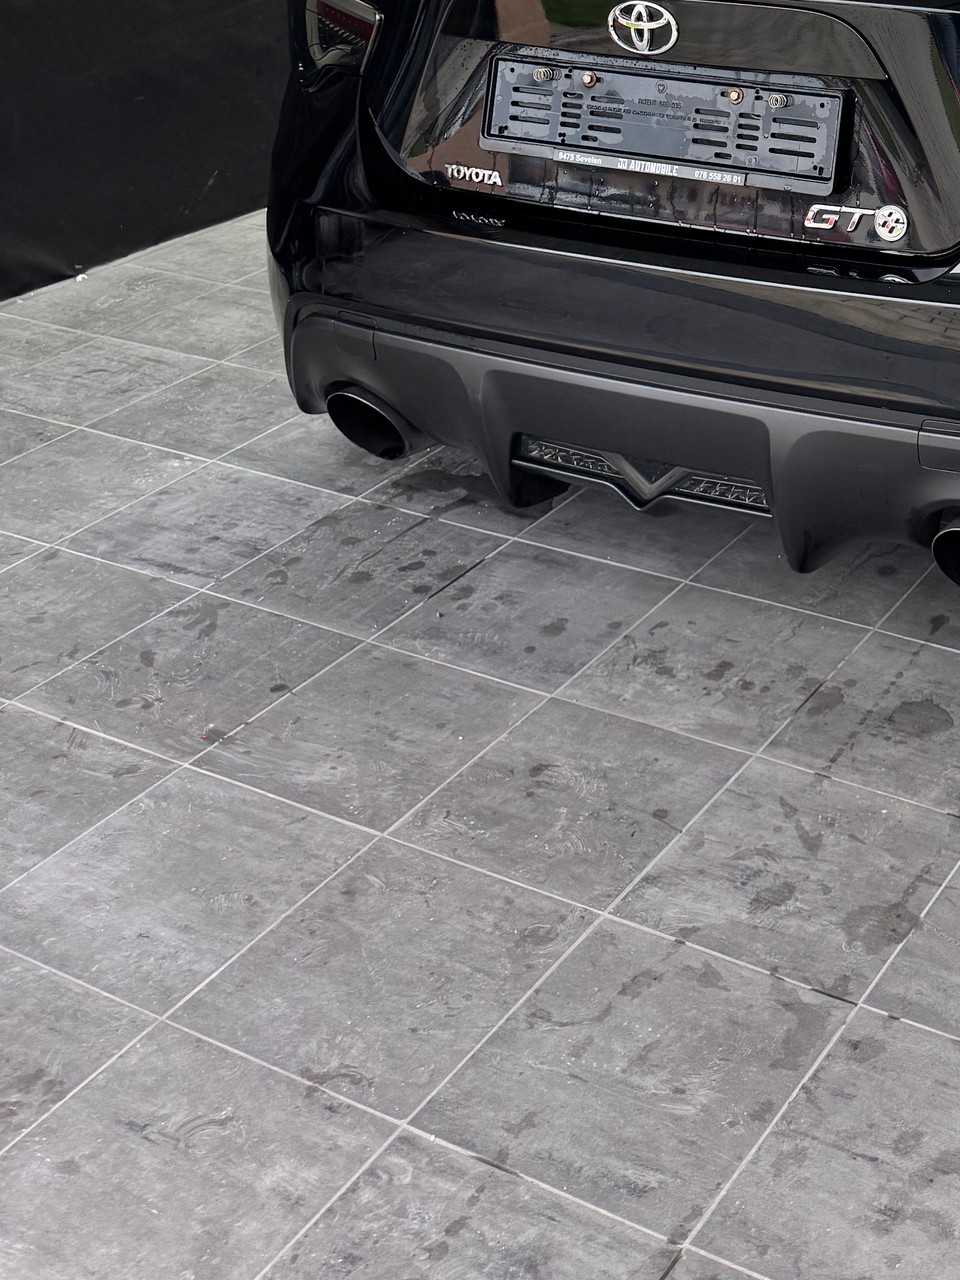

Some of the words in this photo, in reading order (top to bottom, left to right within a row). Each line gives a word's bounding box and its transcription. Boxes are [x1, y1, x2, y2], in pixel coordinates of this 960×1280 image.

[444, 163, 503, 187] TOYOTA
[629, 160, 679, 177] AUTOMOBILE
[694, 170, 707, 179] 076
[708, 172, 721, 181] 558
